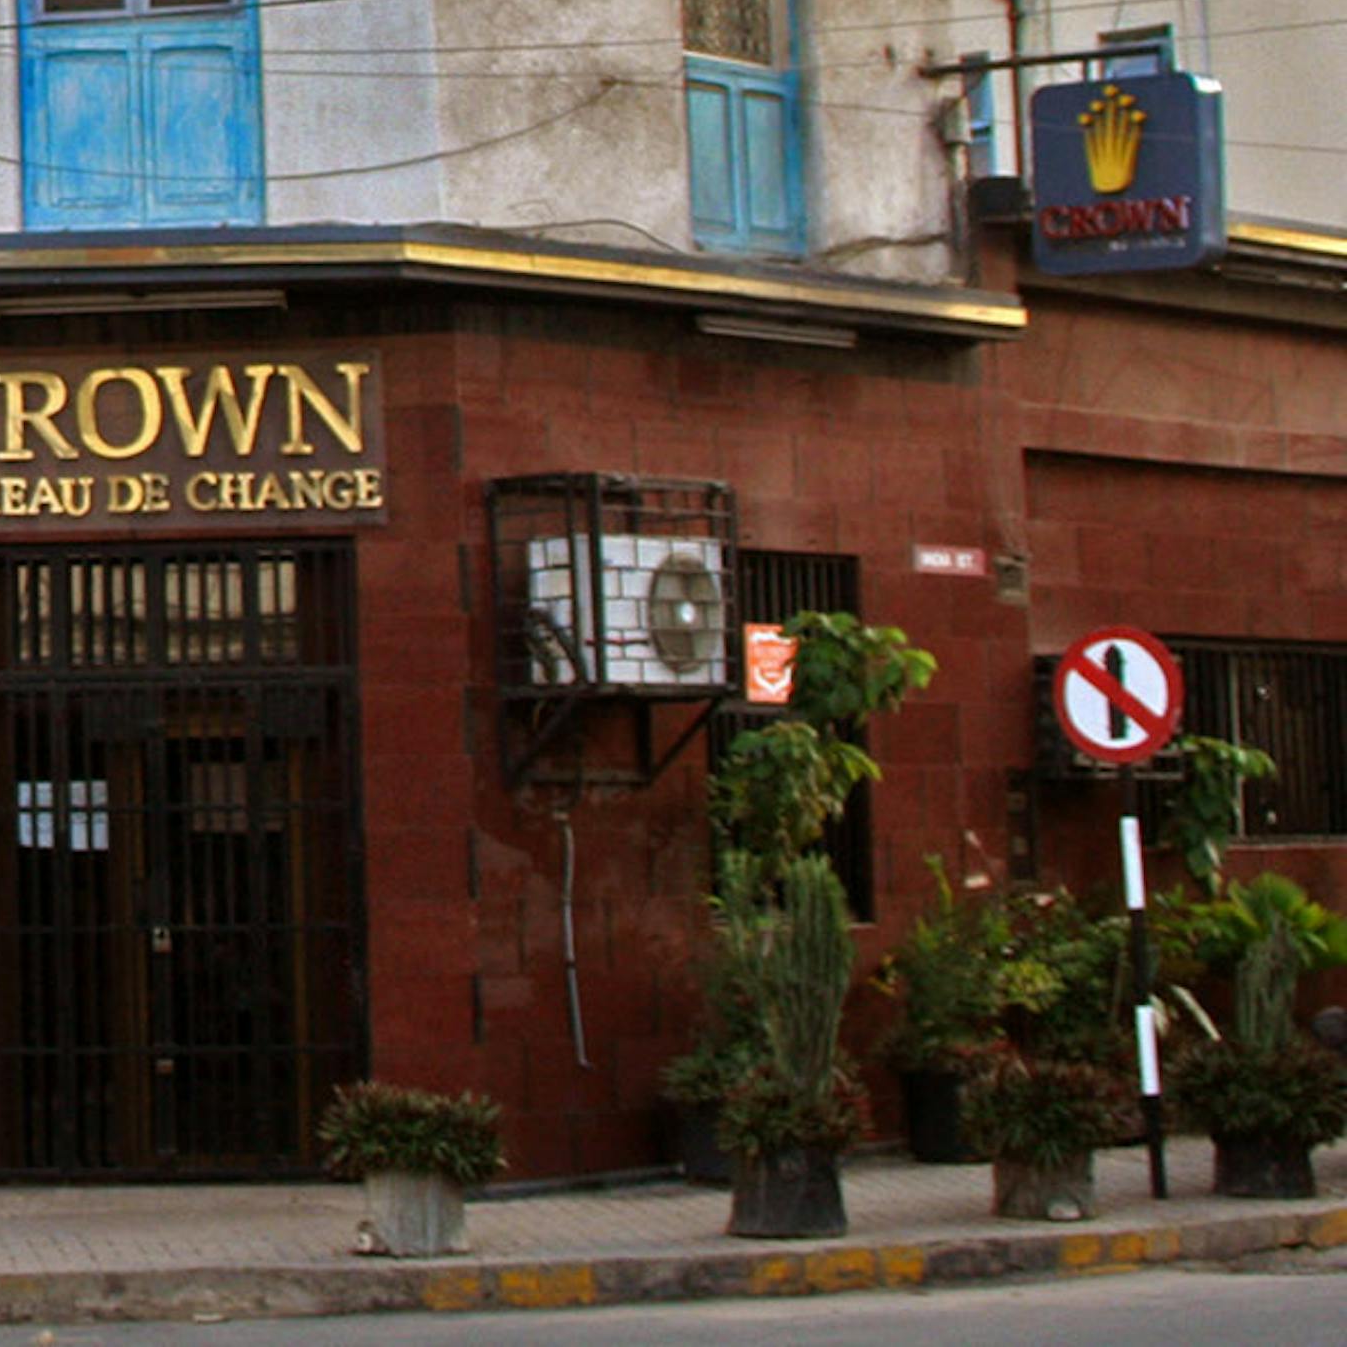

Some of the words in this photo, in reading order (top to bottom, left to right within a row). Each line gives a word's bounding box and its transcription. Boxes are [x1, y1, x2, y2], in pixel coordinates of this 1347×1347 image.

[1040, 196, 1191, 238] CROWN
[108, 473, 170, 514] DE
[185, 469, 384, 513] CHANGE
